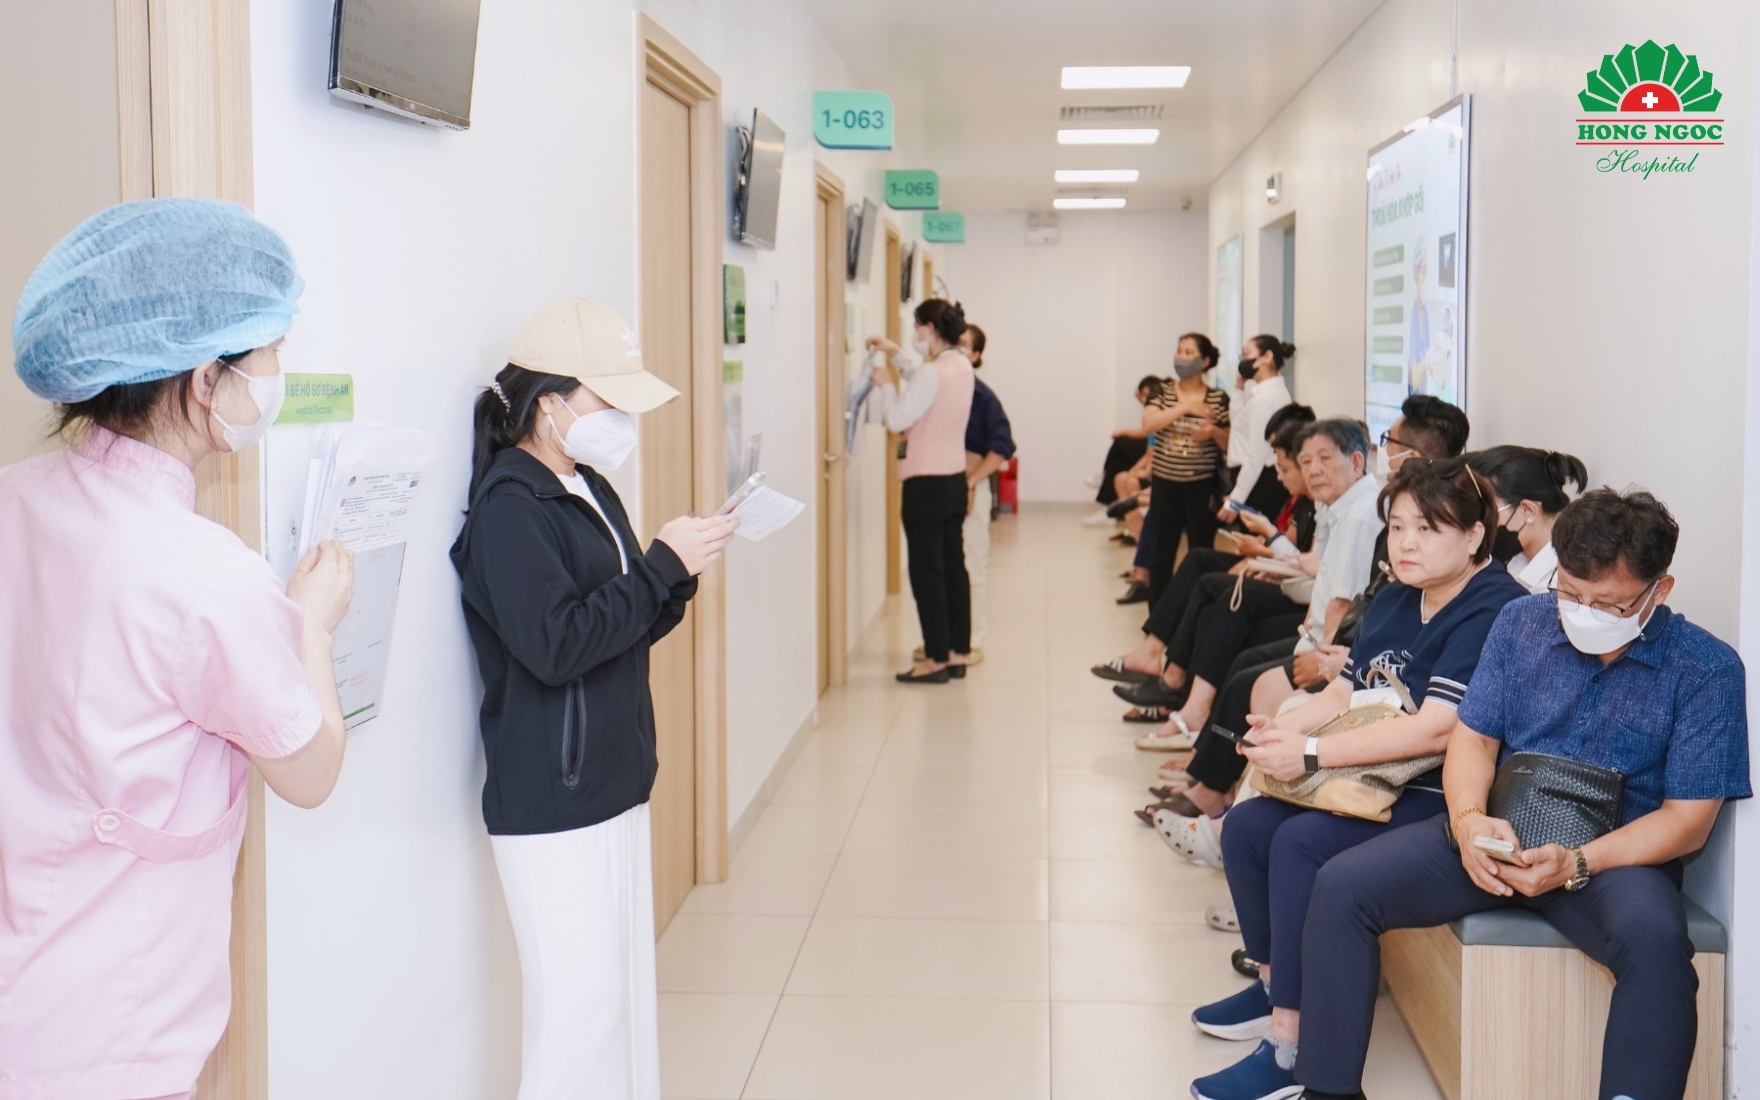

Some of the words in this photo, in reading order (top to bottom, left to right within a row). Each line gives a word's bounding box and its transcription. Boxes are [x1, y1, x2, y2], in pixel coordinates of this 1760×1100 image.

[822, 110, 884, 129] 1-063
[890, 181, 935, 196] 1-065
[311, 382, 321, 397] SƠ
[322, 380, 339, 399] BỆNH
[340, 380, 349, 396] ÁN
[296, 405, 314, 416] Medical
[314, 405, 332, 415] Records
